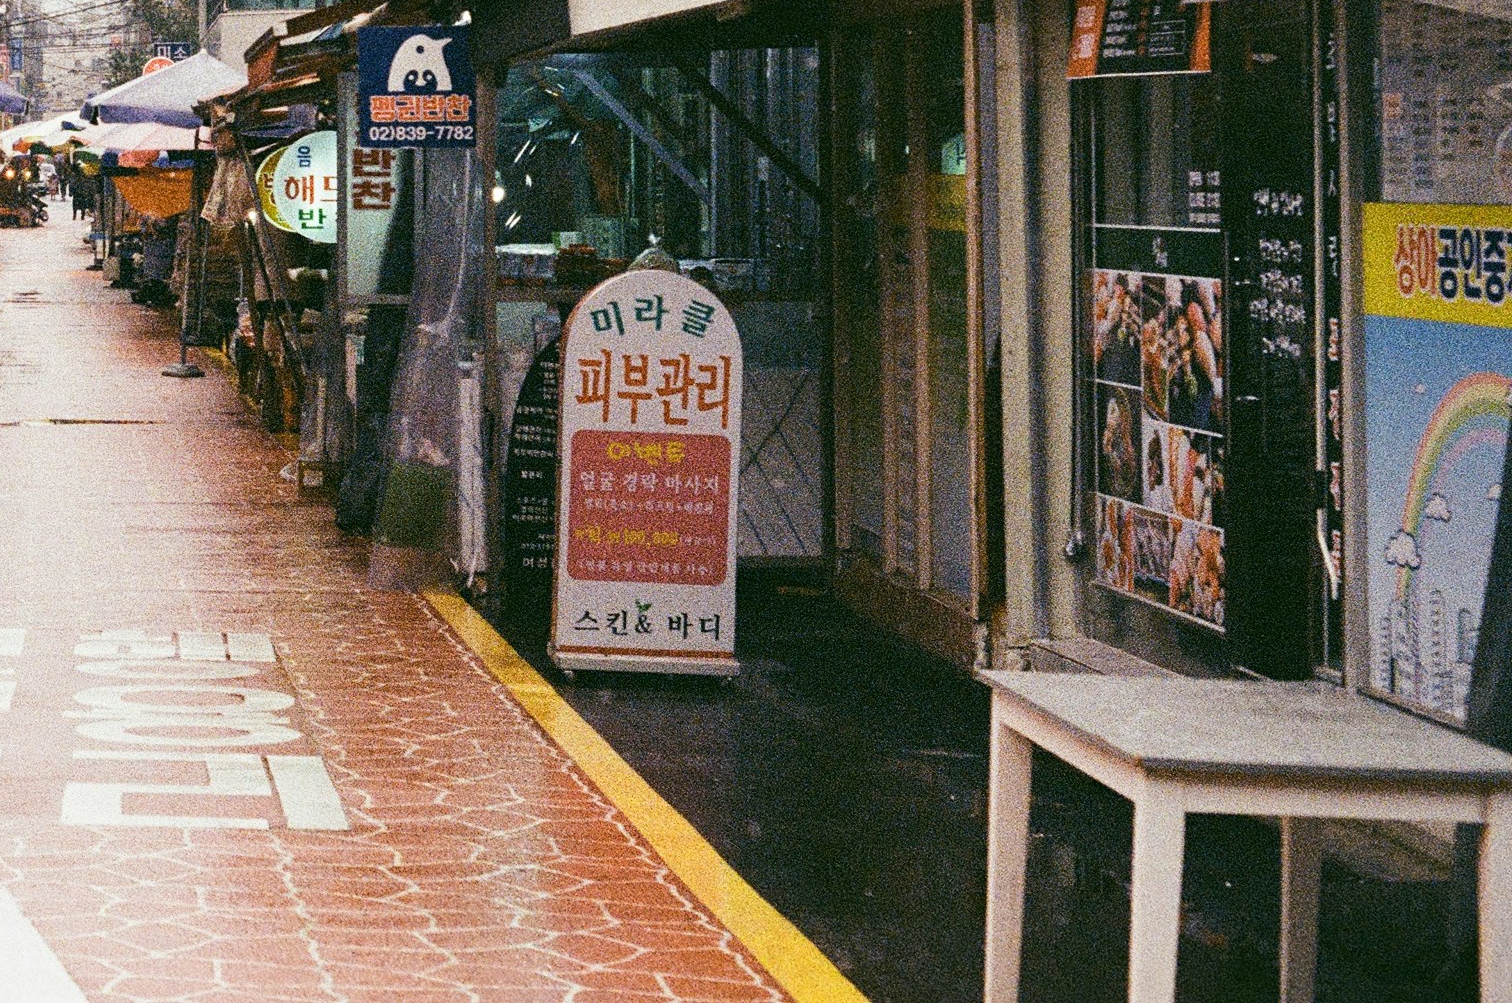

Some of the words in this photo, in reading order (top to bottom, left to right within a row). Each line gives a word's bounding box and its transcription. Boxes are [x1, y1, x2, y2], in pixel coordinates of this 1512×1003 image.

[369, 93, 472, 122] 펭귄반찬
[369, 125, 474, 141] 02)839-7782
[351, 148, 397, 211] 반찬
[1438, 227, 1512, 304] 공인중
[591, 294, 715, 340] 미라클
[575, 348, 732, 429] 피부관리
[606, 440, 686, 467] 이벤트
[579, 470, 615, 492] 얼굴
[623, 471, 659, 493] 경락
[664, 473, 720, 495] 마사지
[668, 612, 722, 640] 바디
